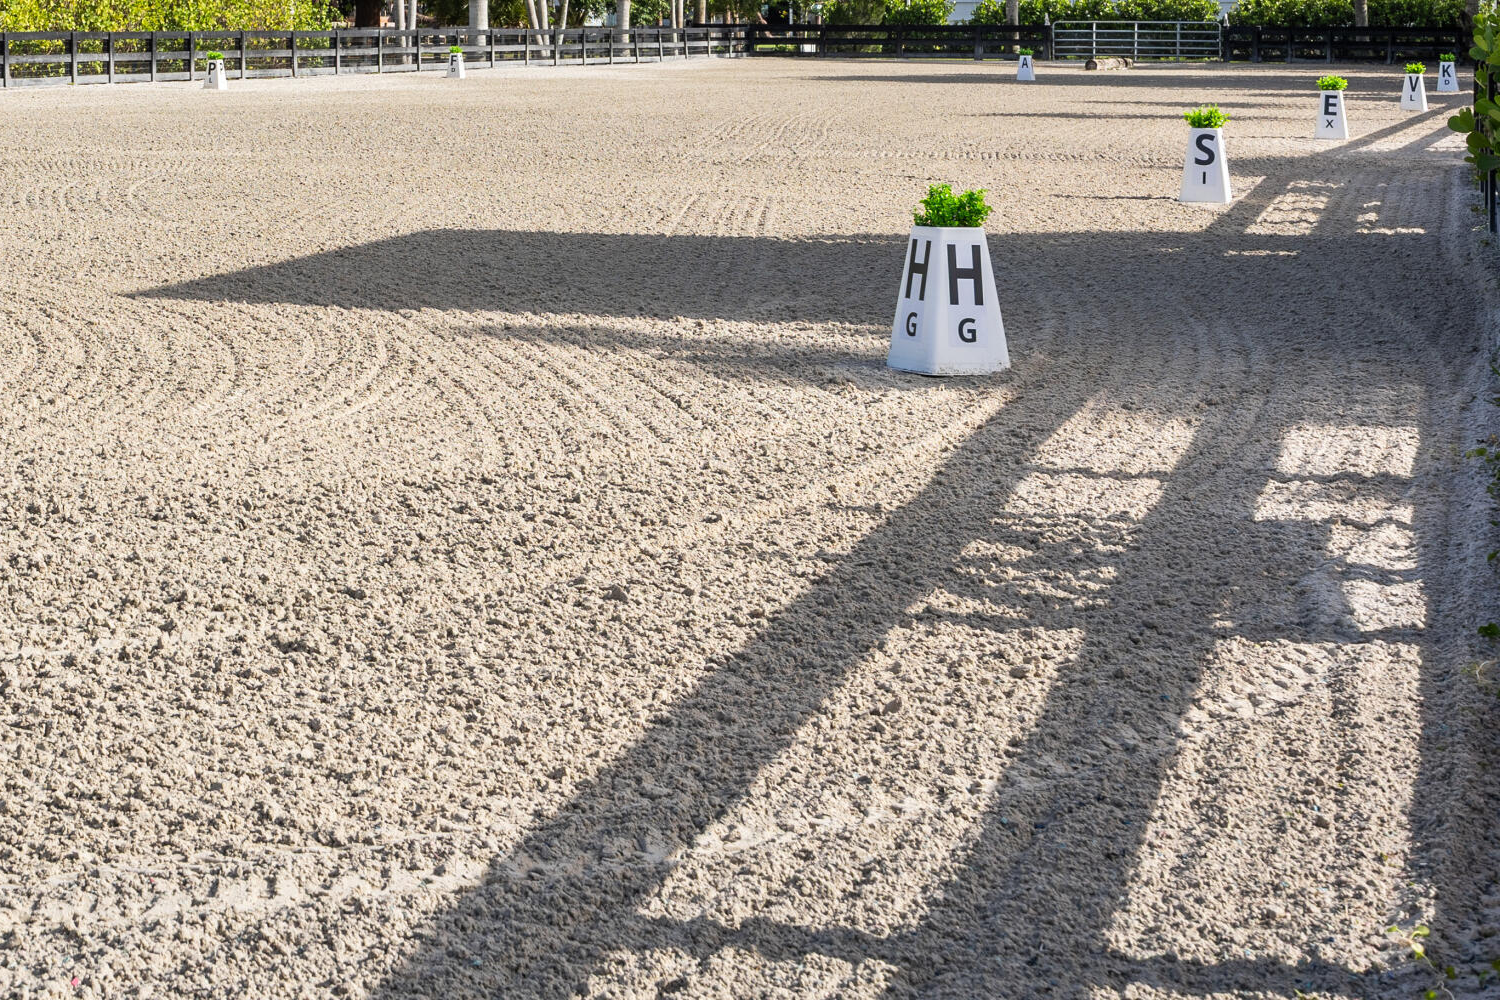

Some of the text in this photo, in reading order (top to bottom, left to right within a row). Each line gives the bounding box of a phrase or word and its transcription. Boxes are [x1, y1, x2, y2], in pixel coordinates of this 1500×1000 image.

[208, 62, 216, 76] P
[450, 55, 457, 66] F
[1021, 57, 1029, 69] A
[1442, 64, 1452, 78] K
[1408, 75, 1420, 92] V
[1323, 94, 1338, 116] E
[1194, 133, 1216, 166] S
[905, 238, 932, 301] H
[946, 243, 984, 306] H
[905, 311, 918, 337] G
[957, 317, 977, 343] G
